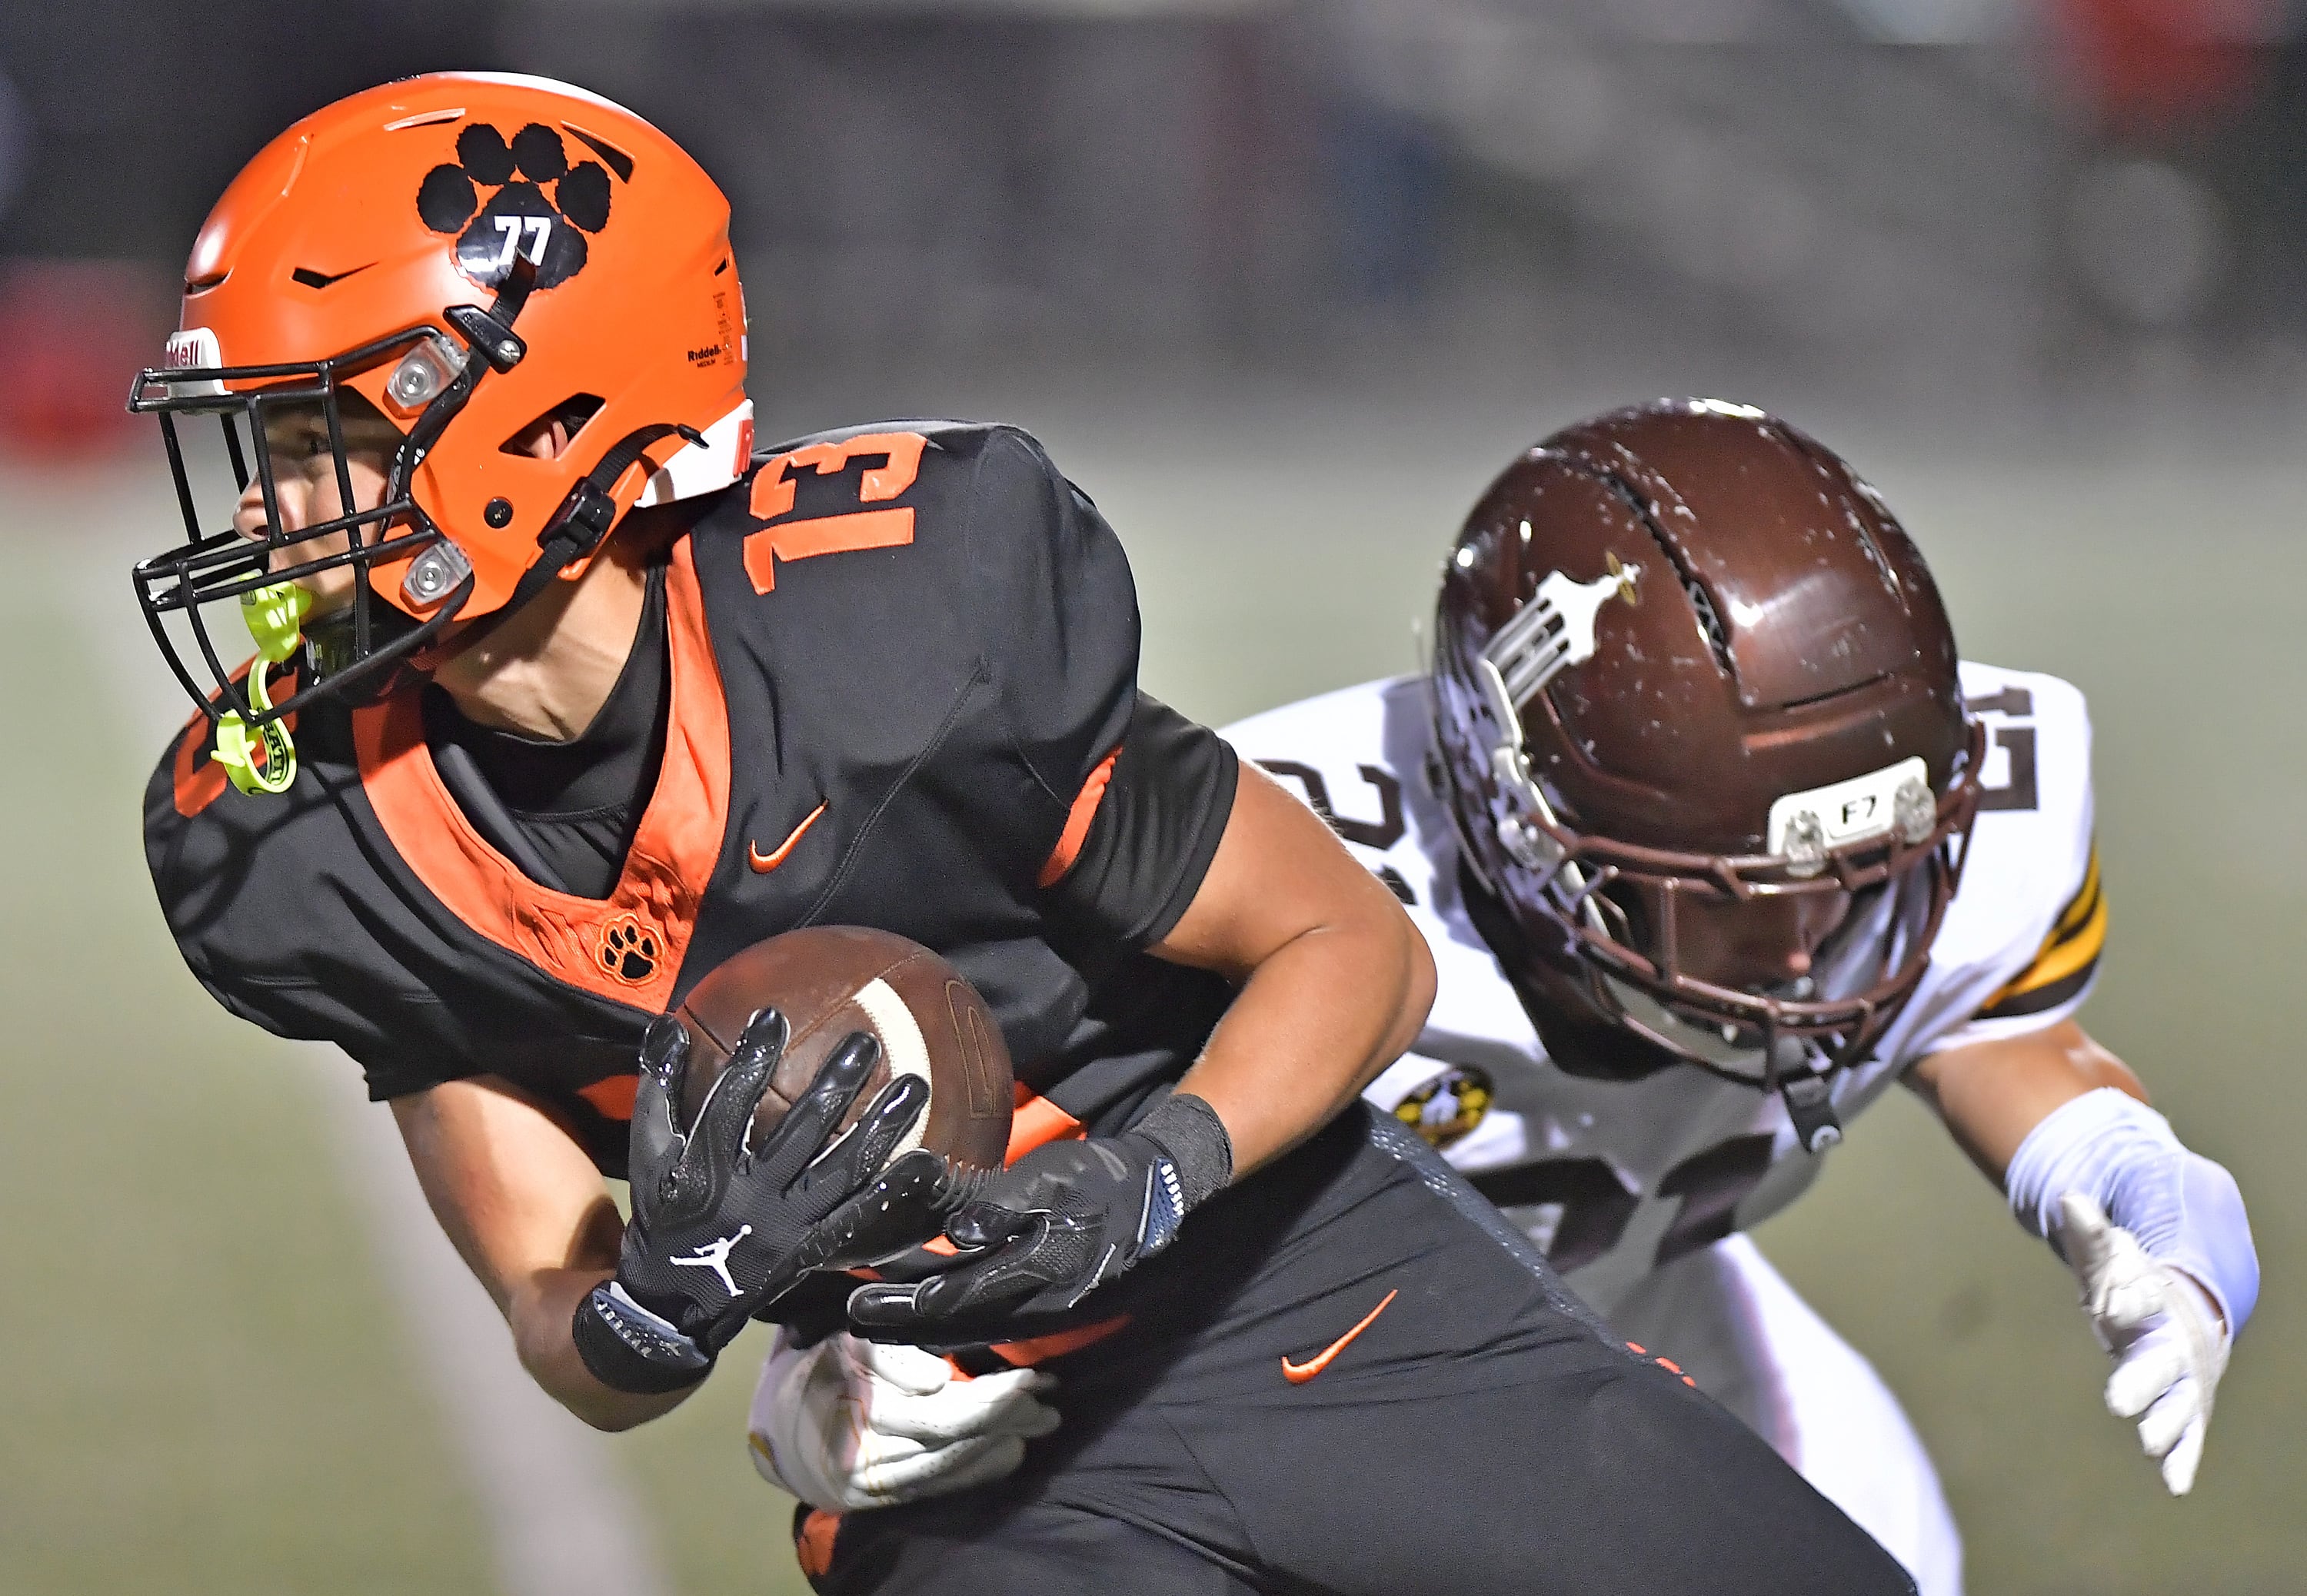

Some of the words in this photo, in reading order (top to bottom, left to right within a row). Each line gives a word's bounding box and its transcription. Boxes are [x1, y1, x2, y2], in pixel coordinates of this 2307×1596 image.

[494, 214, 552, 267] 77
[743, 431, 928, 597] 13
[1841, 794, 1877, 826] F7
